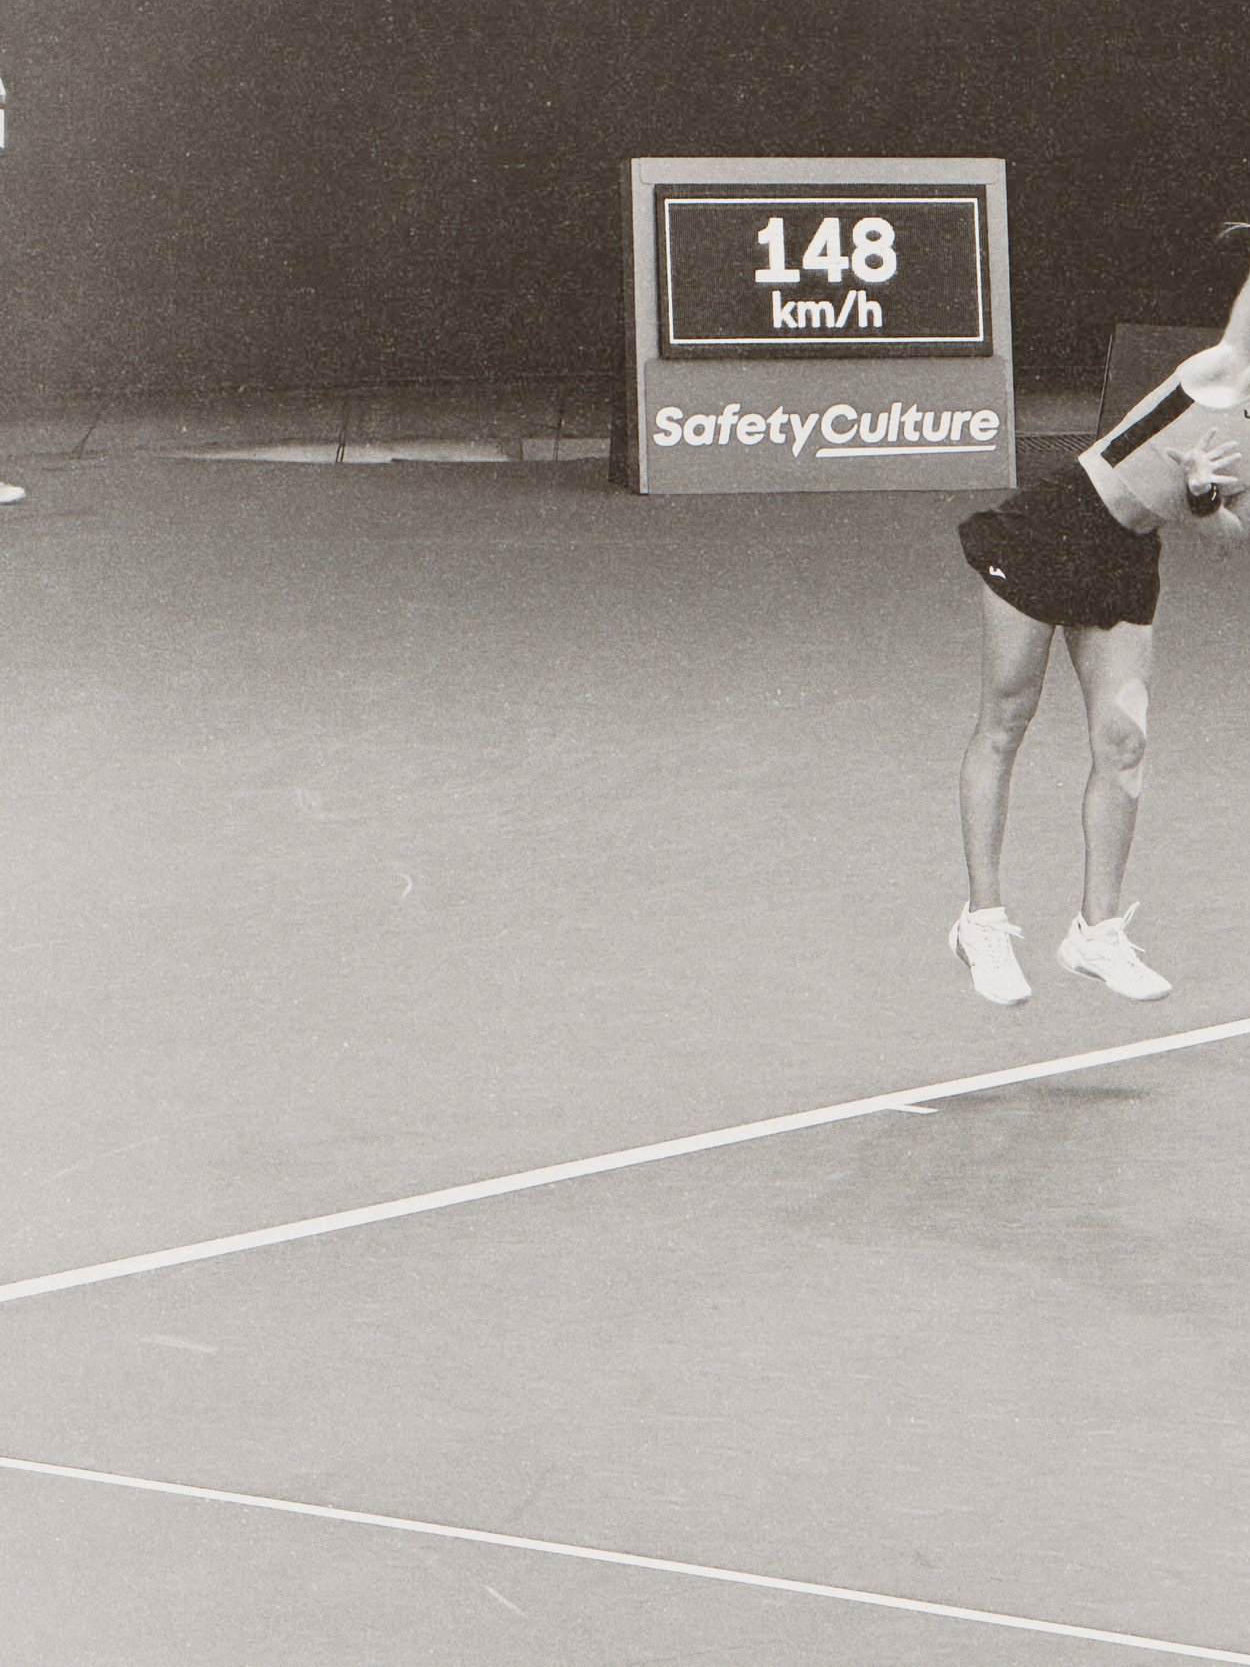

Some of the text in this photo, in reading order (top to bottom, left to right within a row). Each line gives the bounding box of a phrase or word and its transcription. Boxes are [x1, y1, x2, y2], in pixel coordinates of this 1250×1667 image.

[754, 216, 898, 284] 148
[772, 290, 883, 329] km/h
[653, 402, 1000, 458] SafetyCulture
